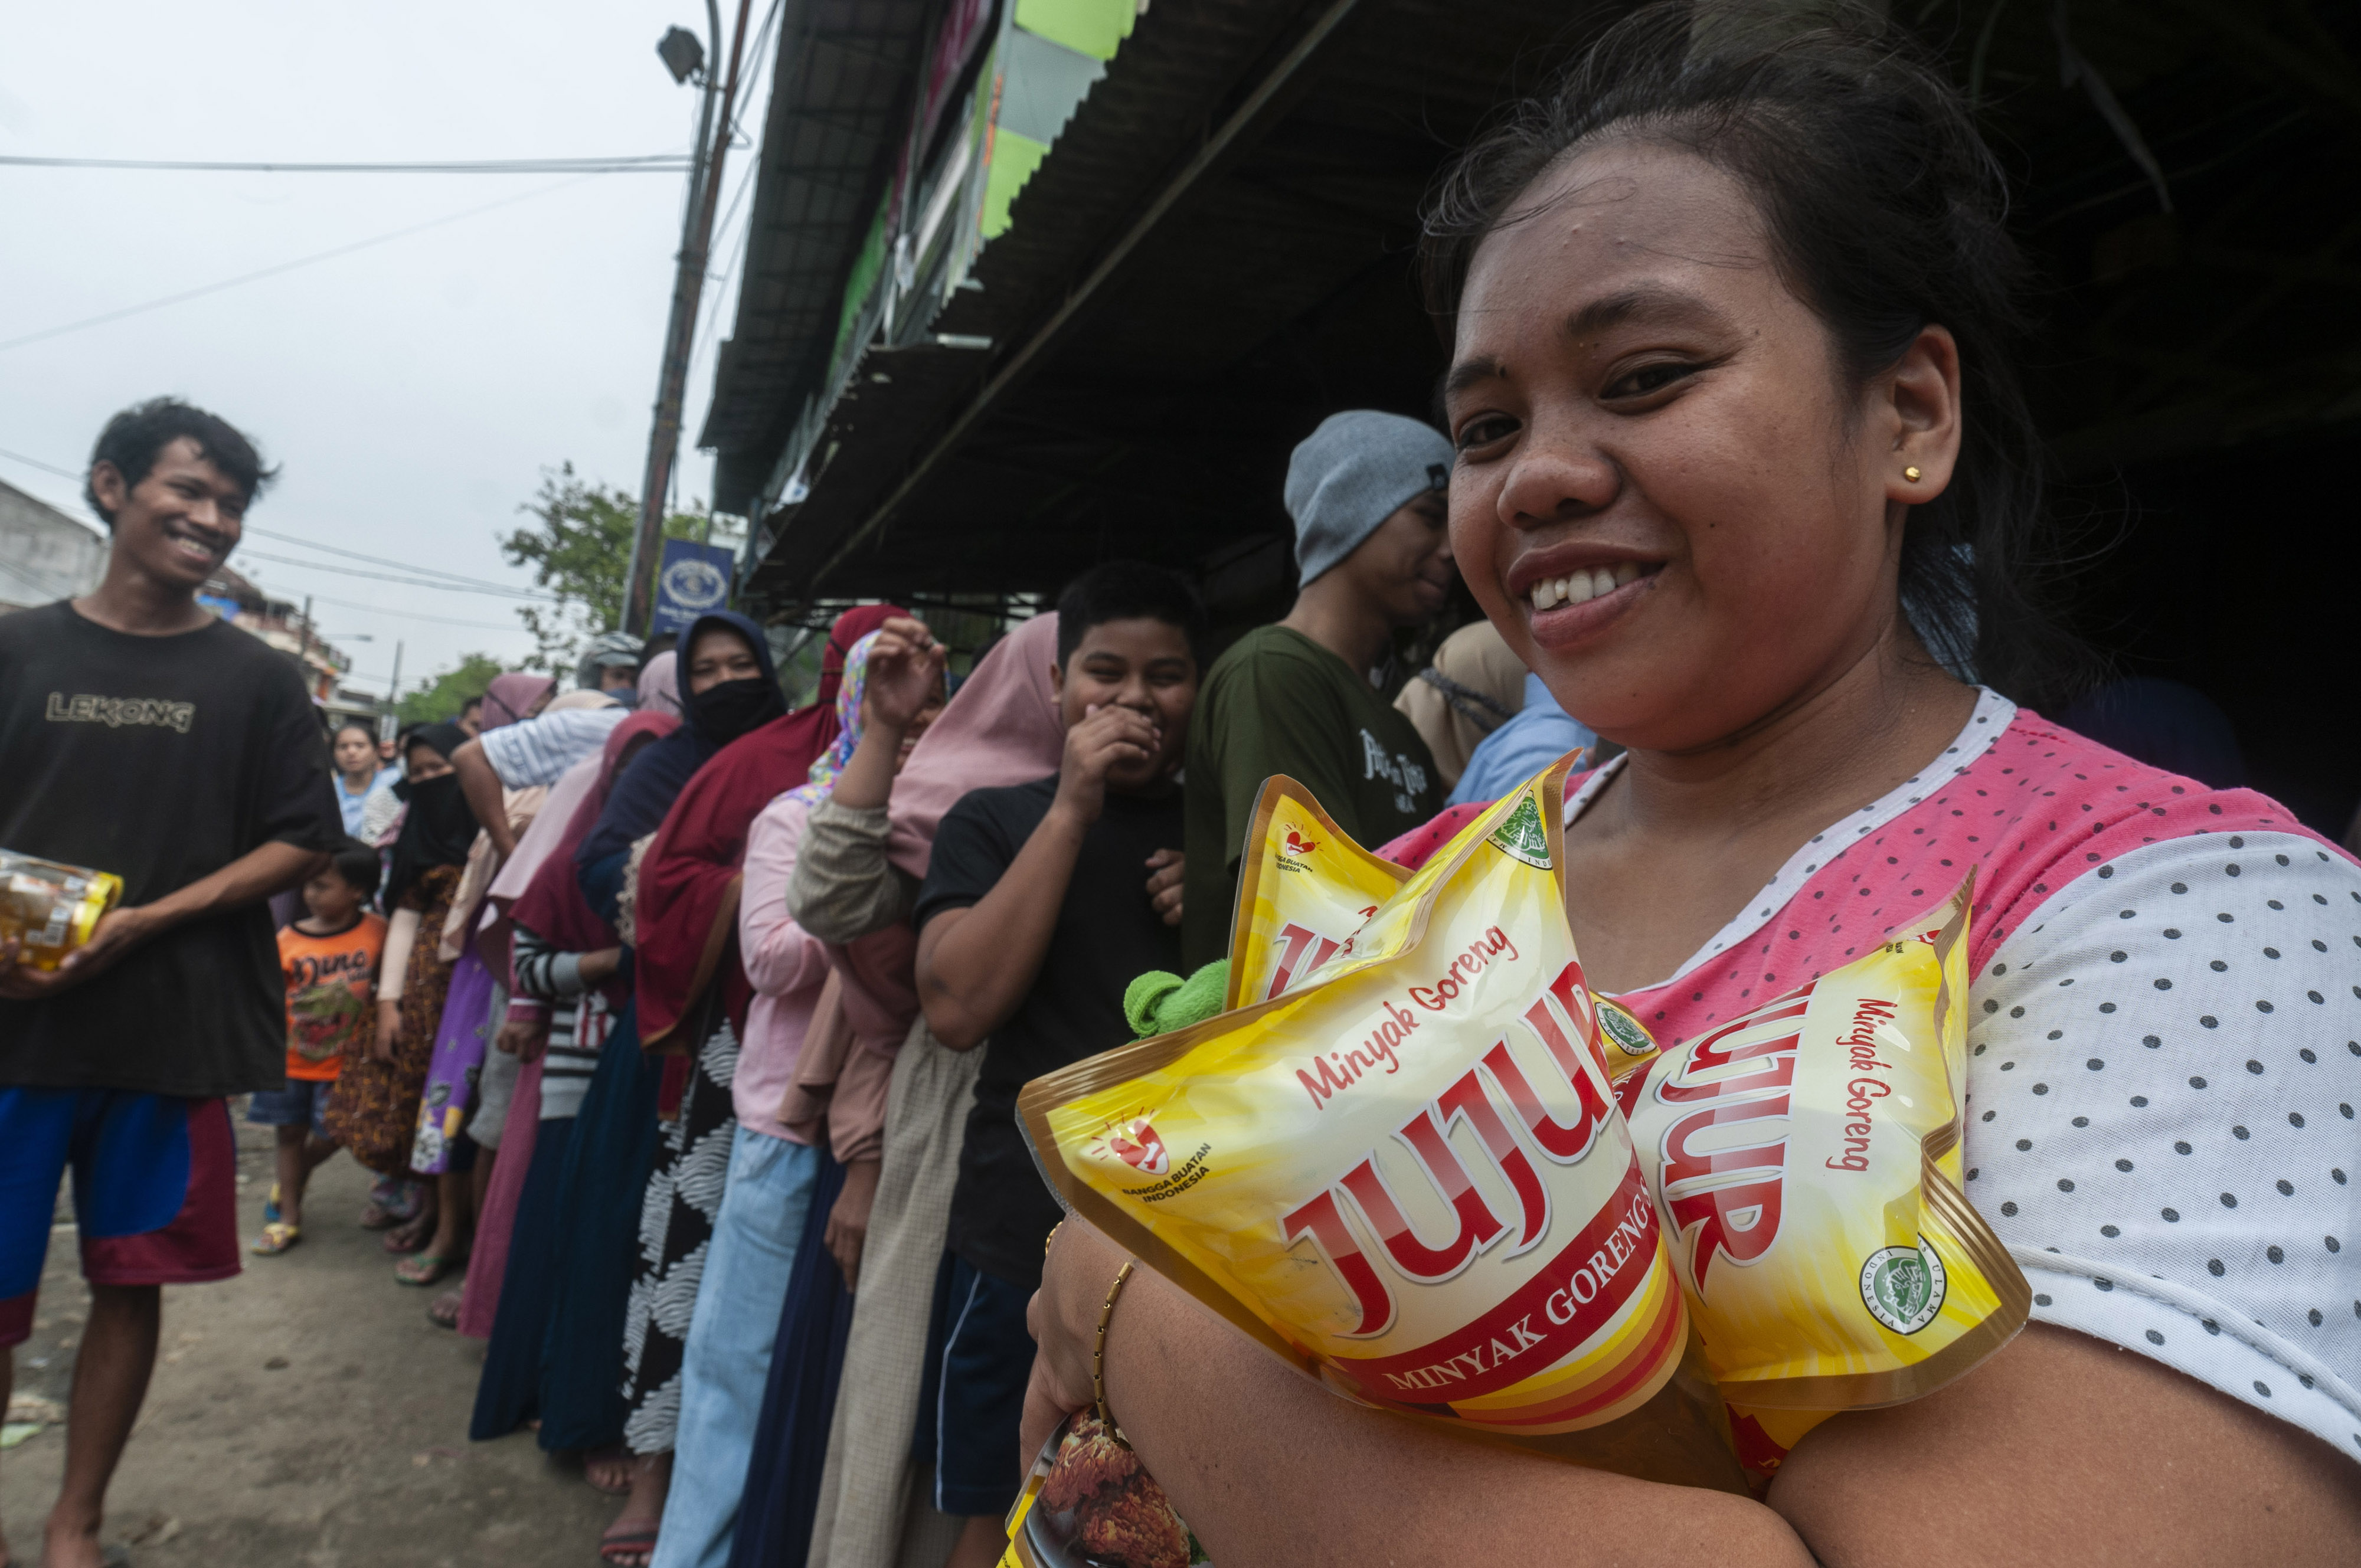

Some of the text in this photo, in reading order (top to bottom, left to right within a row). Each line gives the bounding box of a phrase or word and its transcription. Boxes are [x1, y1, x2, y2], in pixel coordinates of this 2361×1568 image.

[1286, 859, 1313, 872] BUATAN
[1296, 1001, 1421, 1111] Minyak
[1408, 925, 1519, 1011] Goreng
[1599, 1017, 1646, 1054] INDONESIA
[1826, 999, 1898, 1172] Minyak Goreng
[1143, 1166, 1210, 1203] INDONESIA
[1171, 1143, 1212, 1183] BUATAN
[1863, 1250, 1894, 1327] INDONESIA
[1917, 1264, 1943, 1323] ULAMA
[1382, 1314, 1548, 1389] MINYAK
